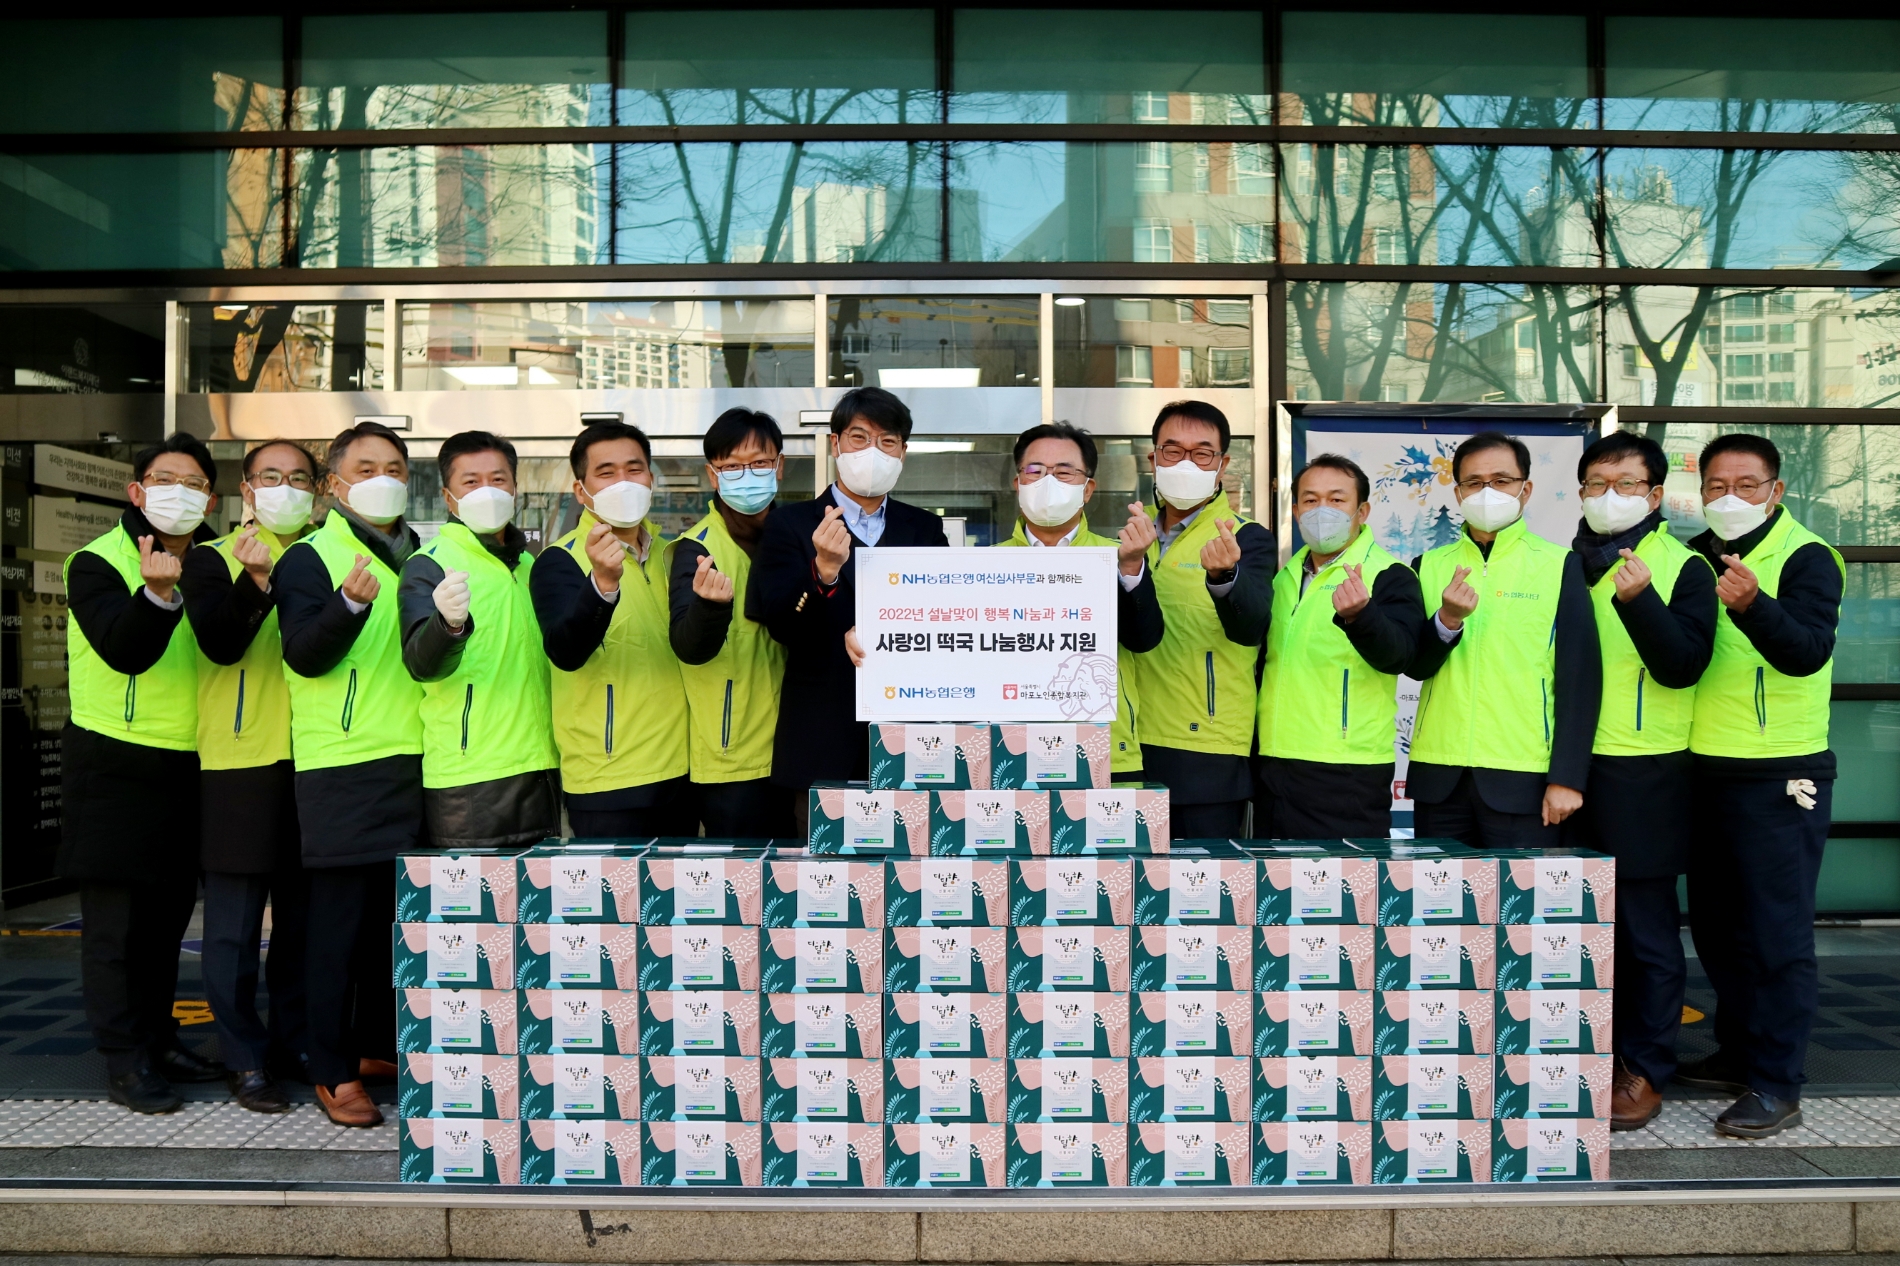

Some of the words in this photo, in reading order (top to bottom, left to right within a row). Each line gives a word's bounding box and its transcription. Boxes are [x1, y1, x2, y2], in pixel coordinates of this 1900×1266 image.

[6, 447, 21, 462] 미션
[6, 507, 21, 522] 비전
[902, 573, 975, 585] NH농협은행
[976, 573, 1045, 585] 여신심사부문과
[1047, 574, 1083, 584] 함께하는
[879, 607, 924, 621] 2022년
[927, 607, 978, 621] 설날맞이
[984, 607, 1011, 621] 행복
[875, 632, 931, 652] 사랑의
[937, 632, 974, 652] 떡국
[980, 632, 1055, 652] 나눔행사
[1059, 632, 1096, 652] 지원
[899, 686, 976, 699] NH농협은행
[1020, 691, 1087, 700] 마포노인종합복지관
